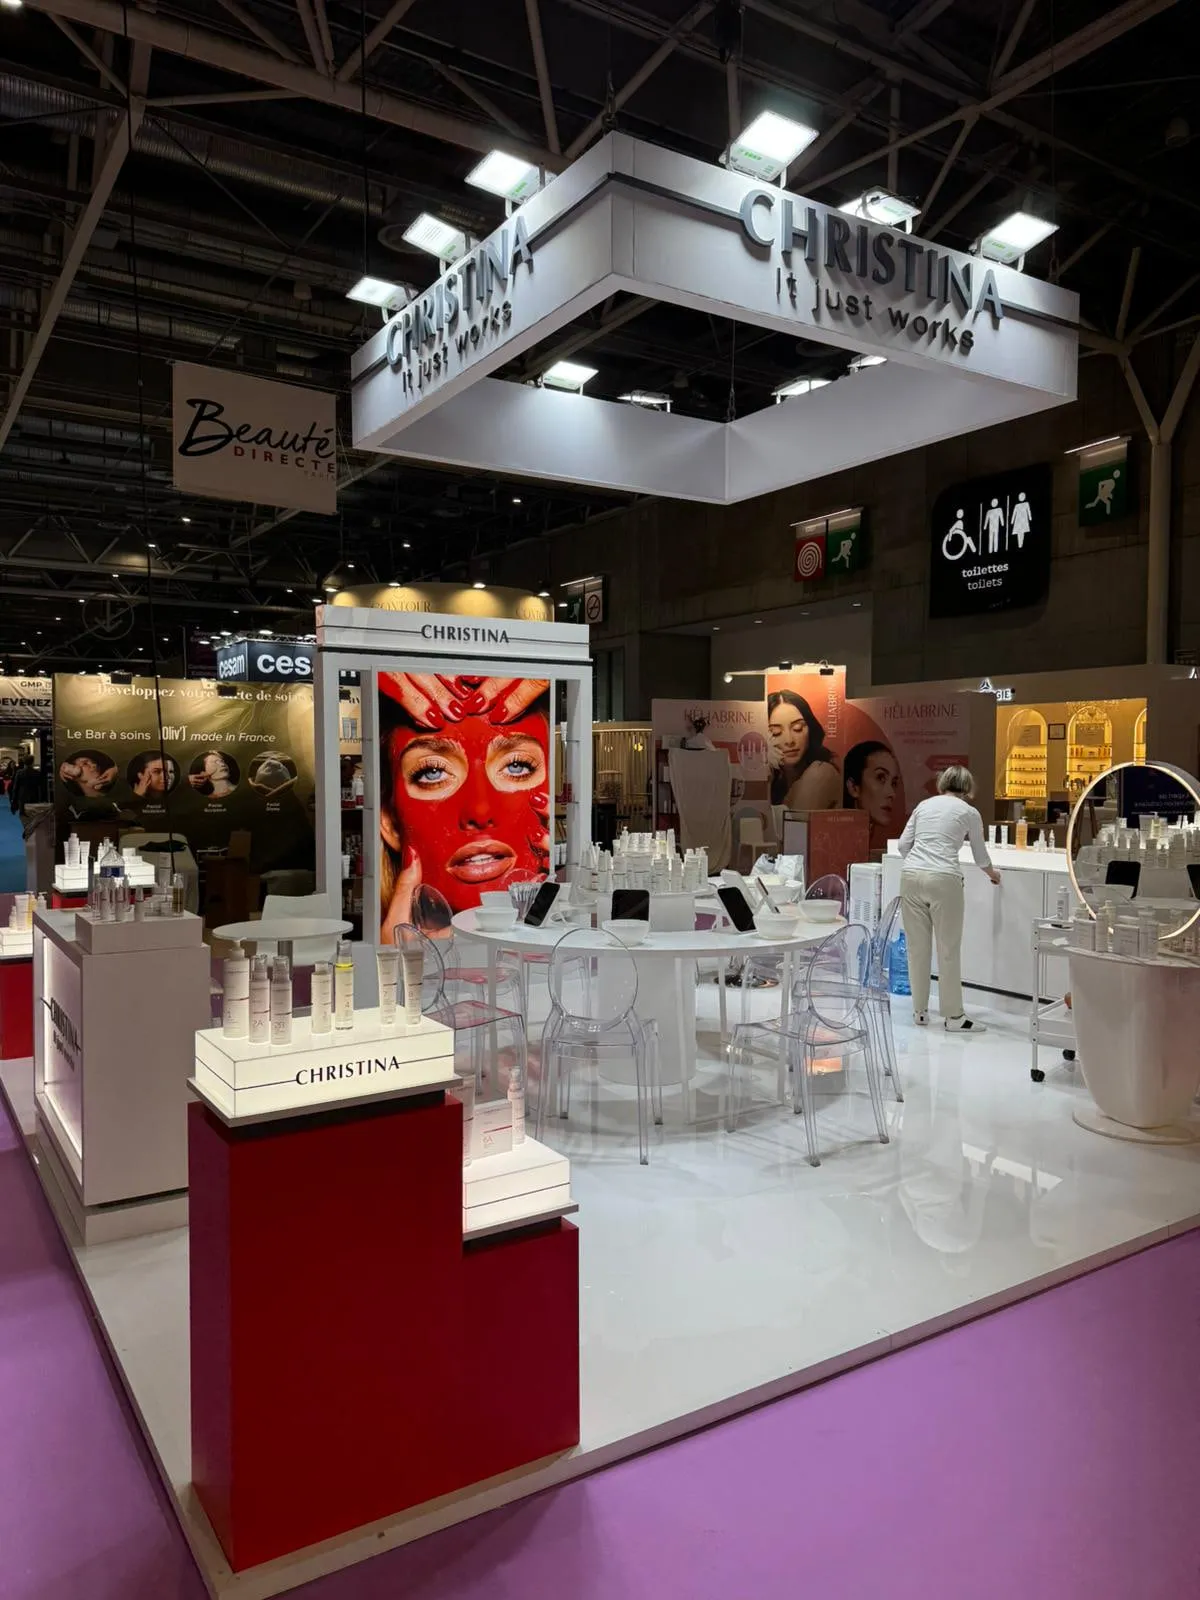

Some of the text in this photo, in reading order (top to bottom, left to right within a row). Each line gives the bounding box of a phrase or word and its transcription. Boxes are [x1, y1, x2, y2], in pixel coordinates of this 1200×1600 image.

[740, 189, 1003, 319] CHRISTINA
[387, 215, 534, 366] CHRISTINA
[776, 267, 975, 350] It just works
[402, 301, 513, 393] It just works
[178, 398, 336, 458] Beauté
[234, 446, 336, 473] DIRECTE
[962, 563, 1009, 578] toilettes
[967, 578, 1003, 591] toilets
[421, 624, 510, 643] CHRISTINA
[218, 655, 245, 679] cesam
[257, 654, 314, 676] ces
[256, 690, 271, 701] de
[67, 729, 82, 739] Le
[85, 729, 106, 740] Bar
[109, 729, 117, 740] à
[120, 730, 151, 740] soins
[190, 733, 223, 741] made
[225, 733, 236, 742] in
[238, 733, 276, 743] France
[295, 1055, 400, 1086] CHRISTINA
